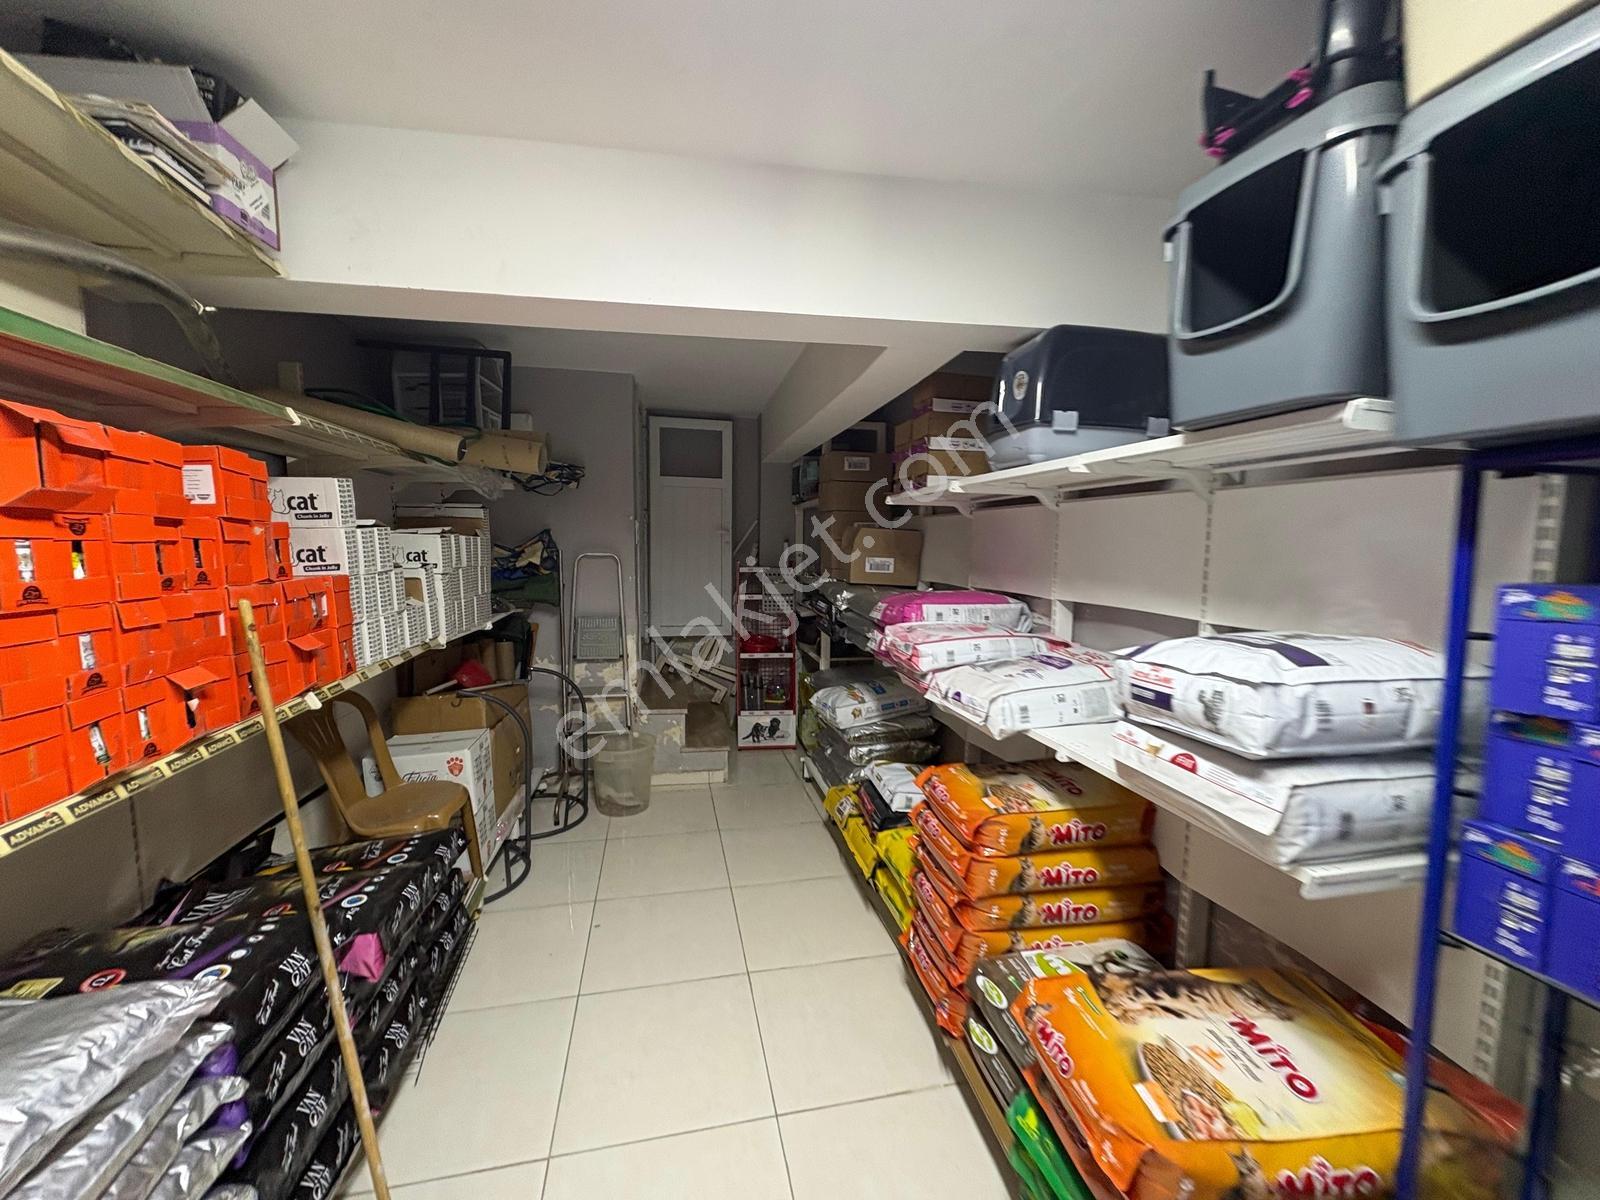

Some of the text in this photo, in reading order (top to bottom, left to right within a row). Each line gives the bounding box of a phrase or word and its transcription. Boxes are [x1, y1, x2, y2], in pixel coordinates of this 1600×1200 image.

[287, 493, 318, 511] cat
[296, 545, 327, 563] cat
[406, 550, 428, 562] cat
[73, 790, 118, 816] ADVANCE
[9, 814, 63, 845] ADVANCE
[279, 946, 306, 974] VAN
[291, 959, 312, 987] CAT
[286, 1014, 313, 1043] VAN
[299, 1027, 318, 1057] CAT
[296, 1085, 321, 1114] VAN
[309, 1096, 328, 1127] CAT
[300, 1160, 326, 1188] VAN
